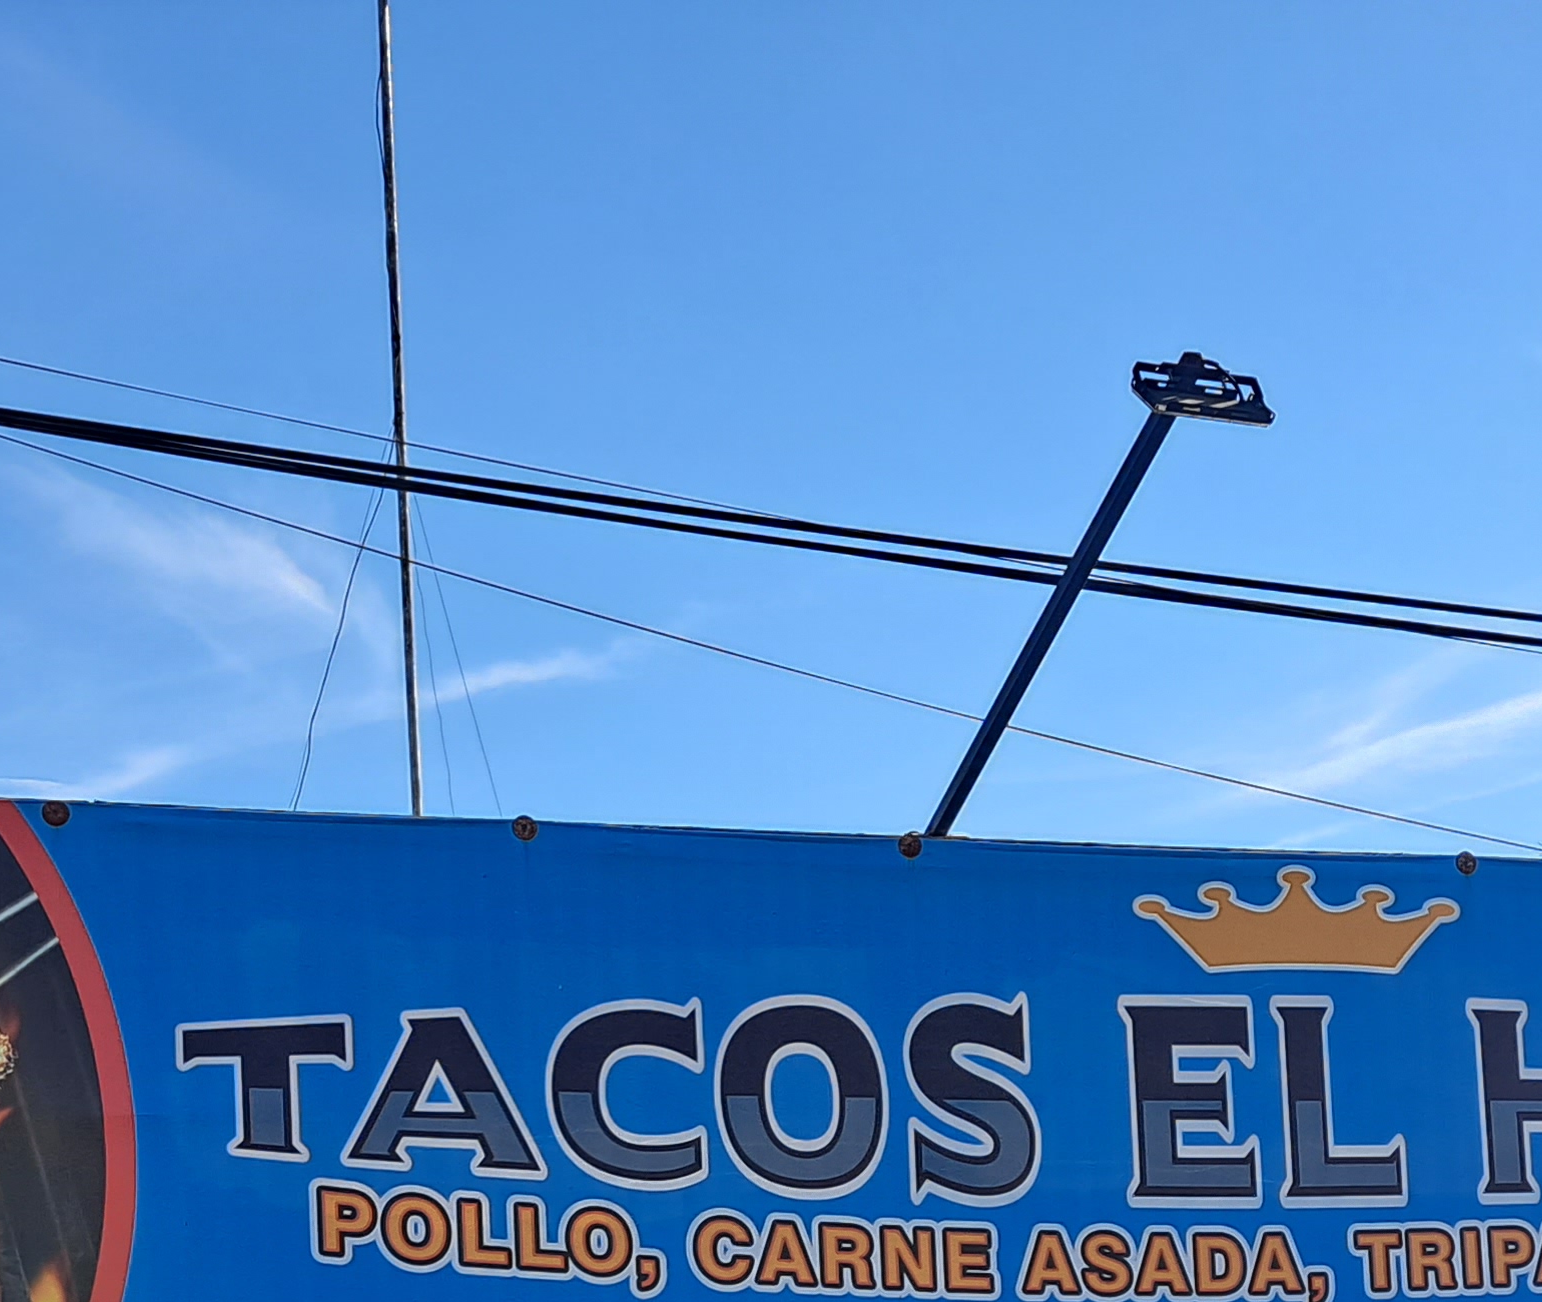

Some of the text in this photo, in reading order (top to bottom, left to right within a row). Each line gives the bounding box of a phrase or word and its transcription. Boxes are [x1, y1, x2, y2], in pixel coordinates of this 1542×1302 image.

[176, 991, 1040, 1206] TACOS
[1118, 995, 1407, 1208] EL
[310, 1179, 665, 1298] POLLO,
[687, 1208, 1000, 1301] CARNE
